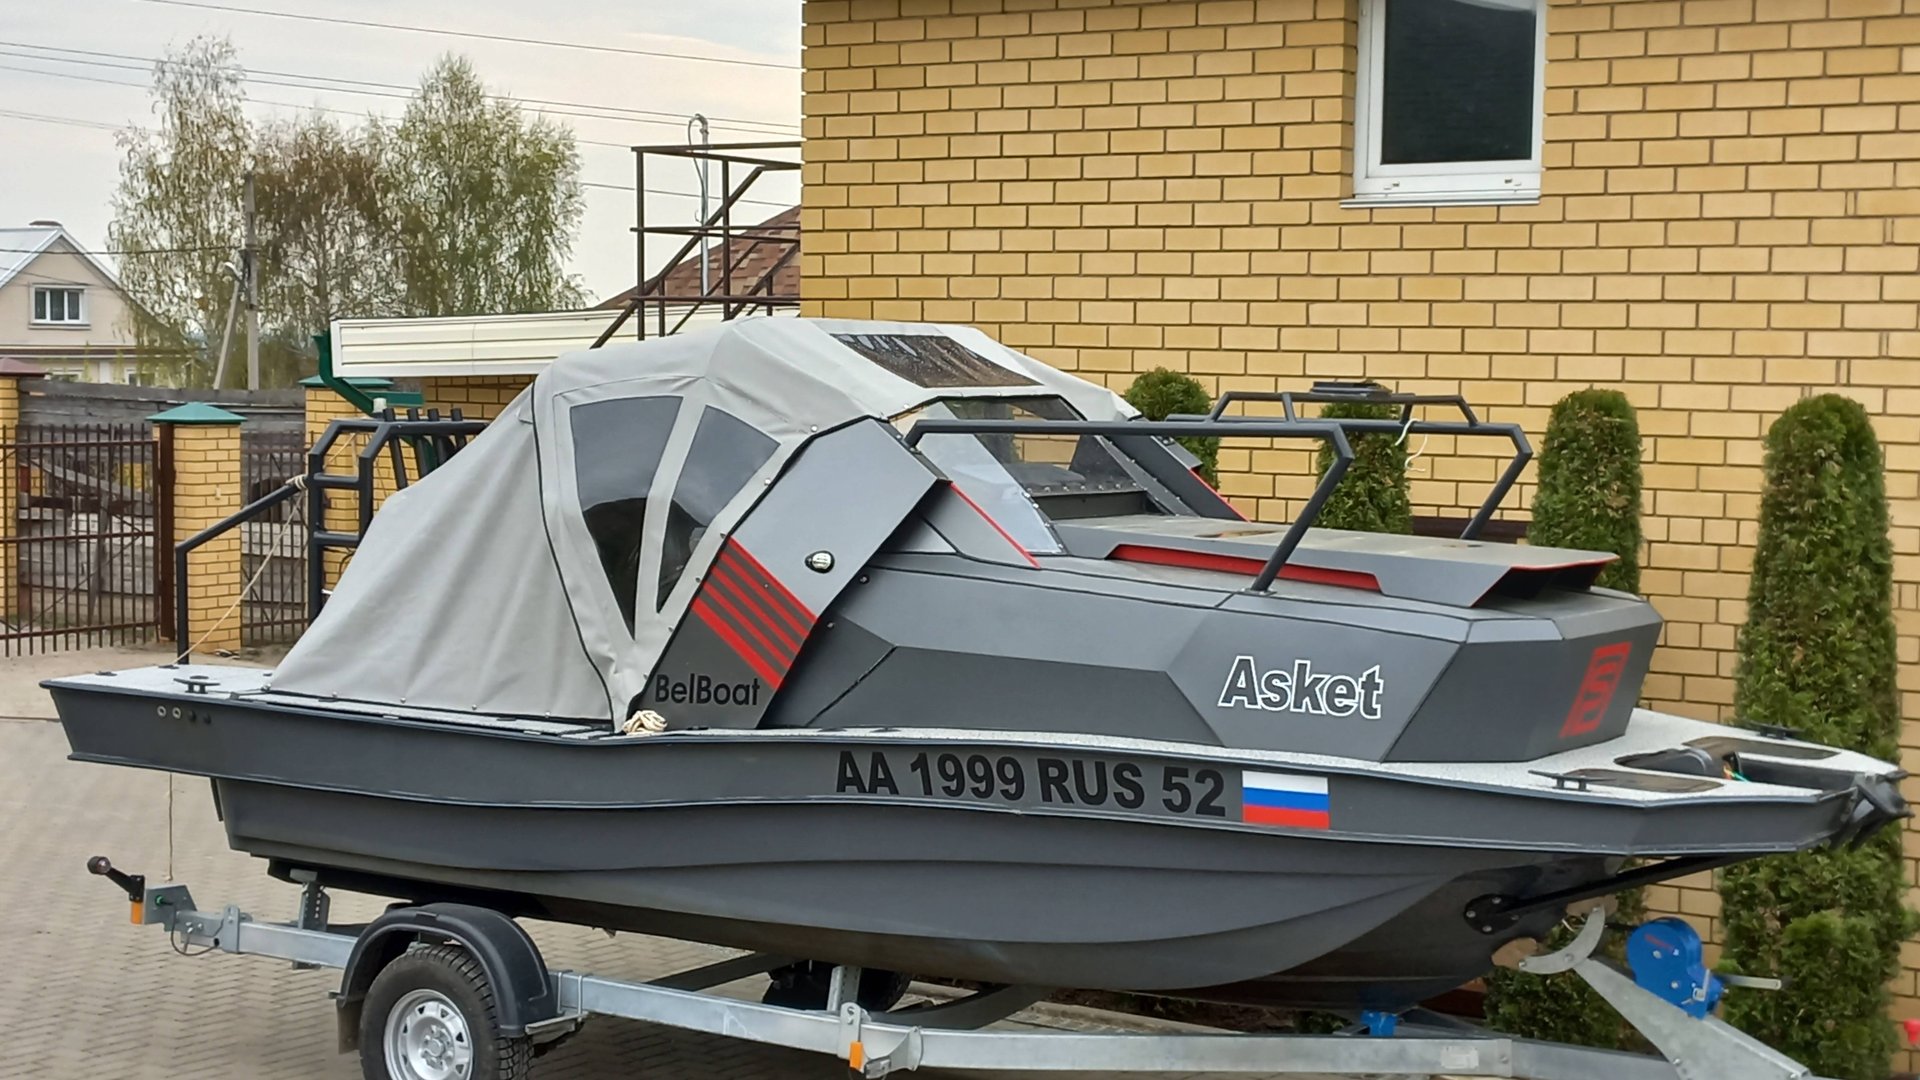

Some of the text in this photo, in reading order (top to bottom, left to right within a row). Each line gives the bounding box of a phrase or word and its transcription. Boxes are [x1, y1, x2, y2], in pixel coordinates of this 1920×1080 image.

[655, 673, 760, 705] BelBoat
[1217, 655, 1384, 719] Asket
[836, 751, 1226, 817] AA 1999 RUS 52
